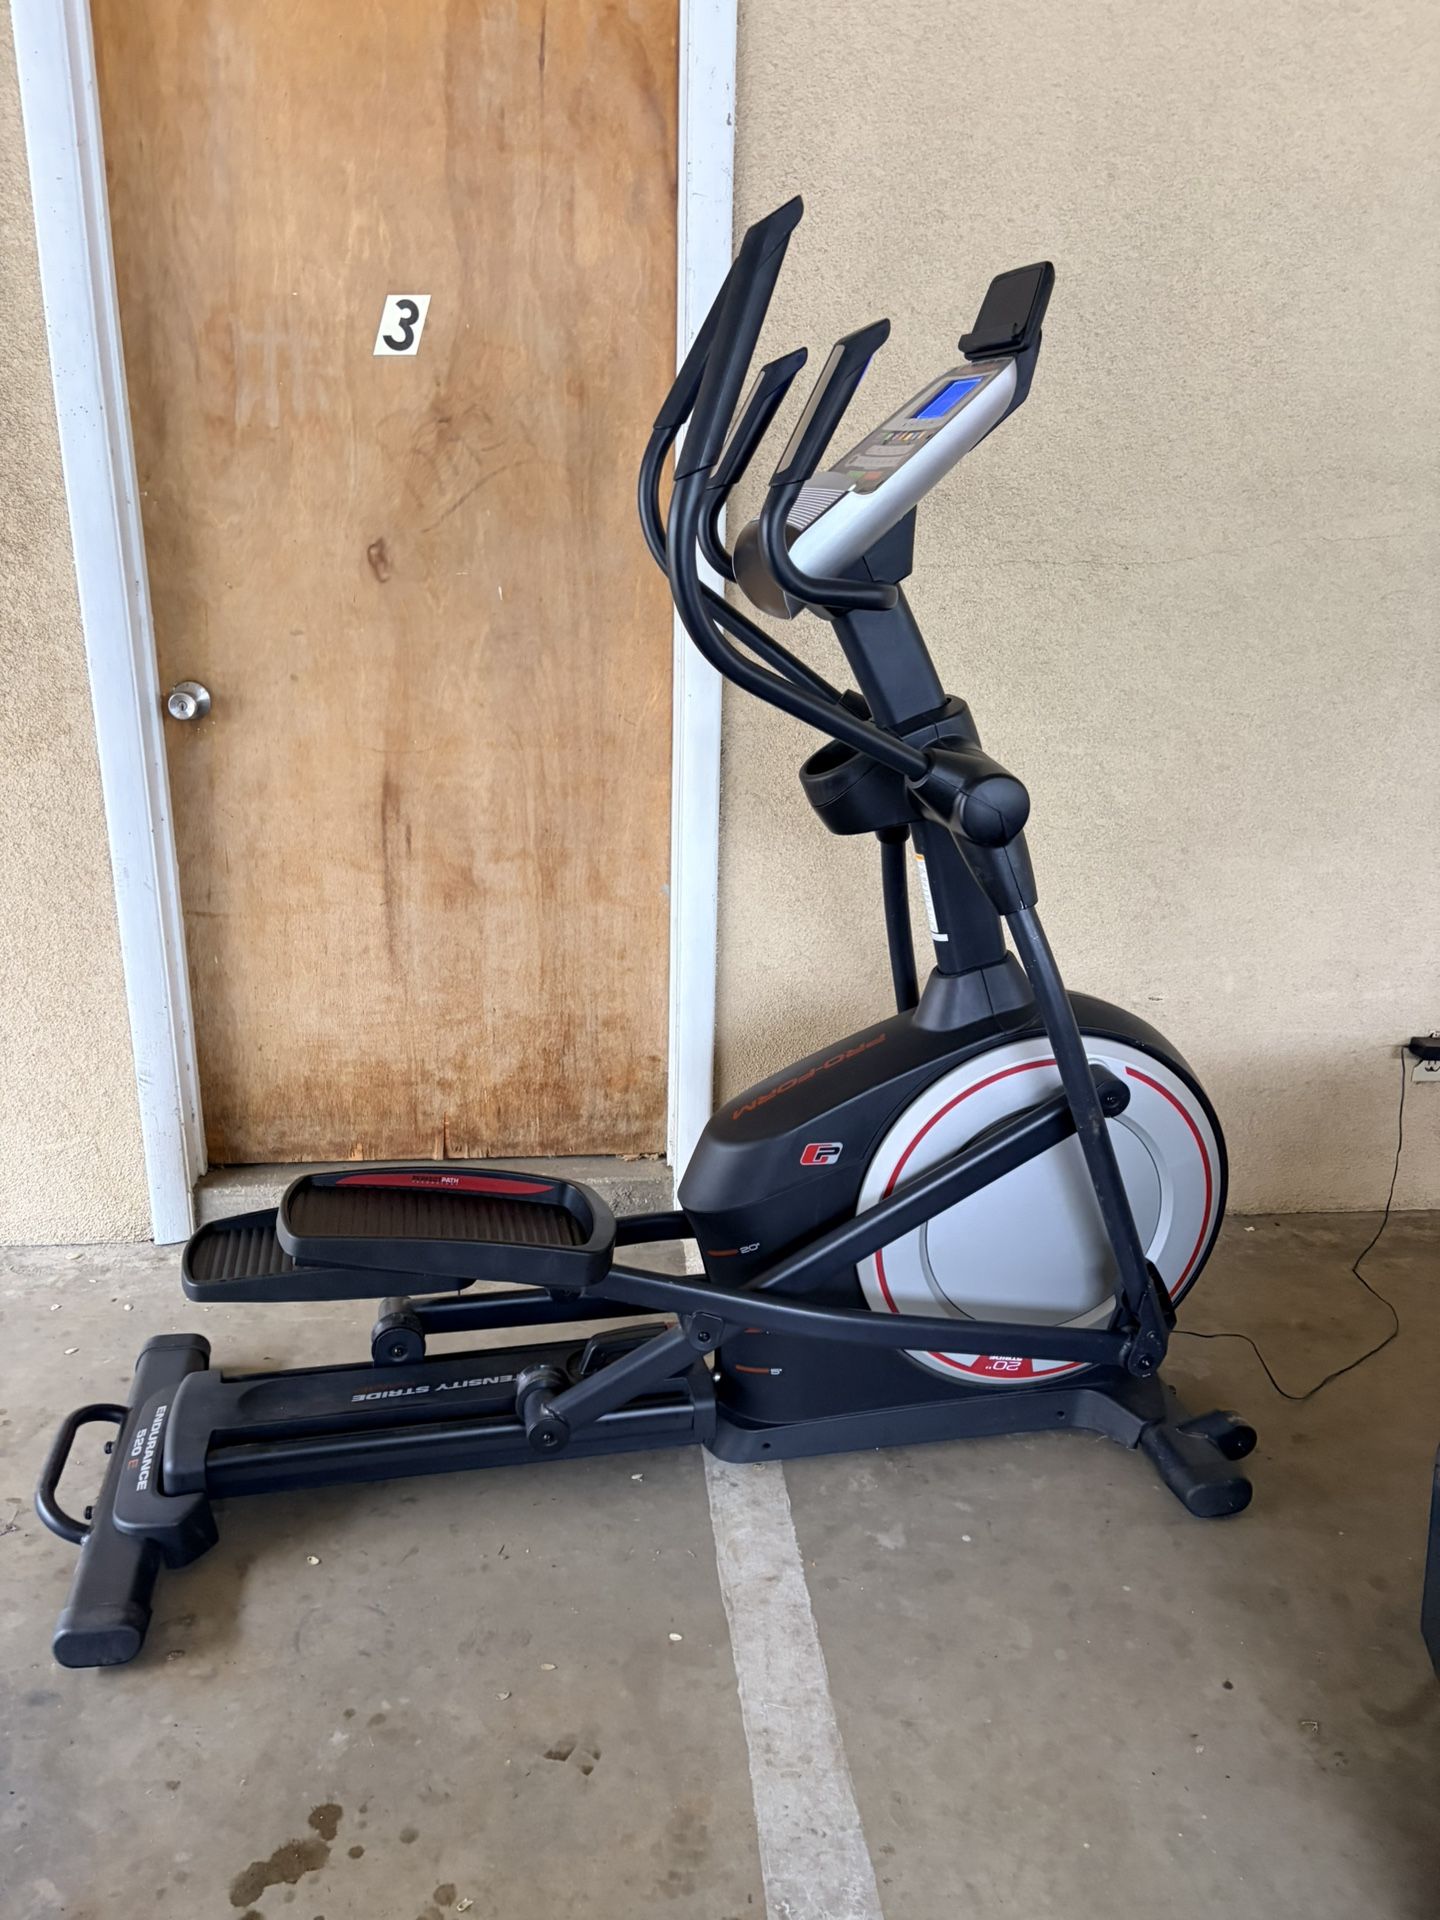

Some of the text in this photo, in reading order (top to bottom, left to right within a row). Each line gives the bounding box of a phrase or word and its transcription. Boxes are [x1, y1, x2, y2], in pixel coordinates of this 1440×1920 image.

[383, 299, 419, 351] 3
[732, 1034, 886, 1120] PRO-FORM
[351, 1385, 430, 1402] STRIDE
[435, 1373, 520, 1391] TENSITY
[127, 1428, 147, 1469] 520 E
[136, 1405, 168, 1491] ENDURANCE
